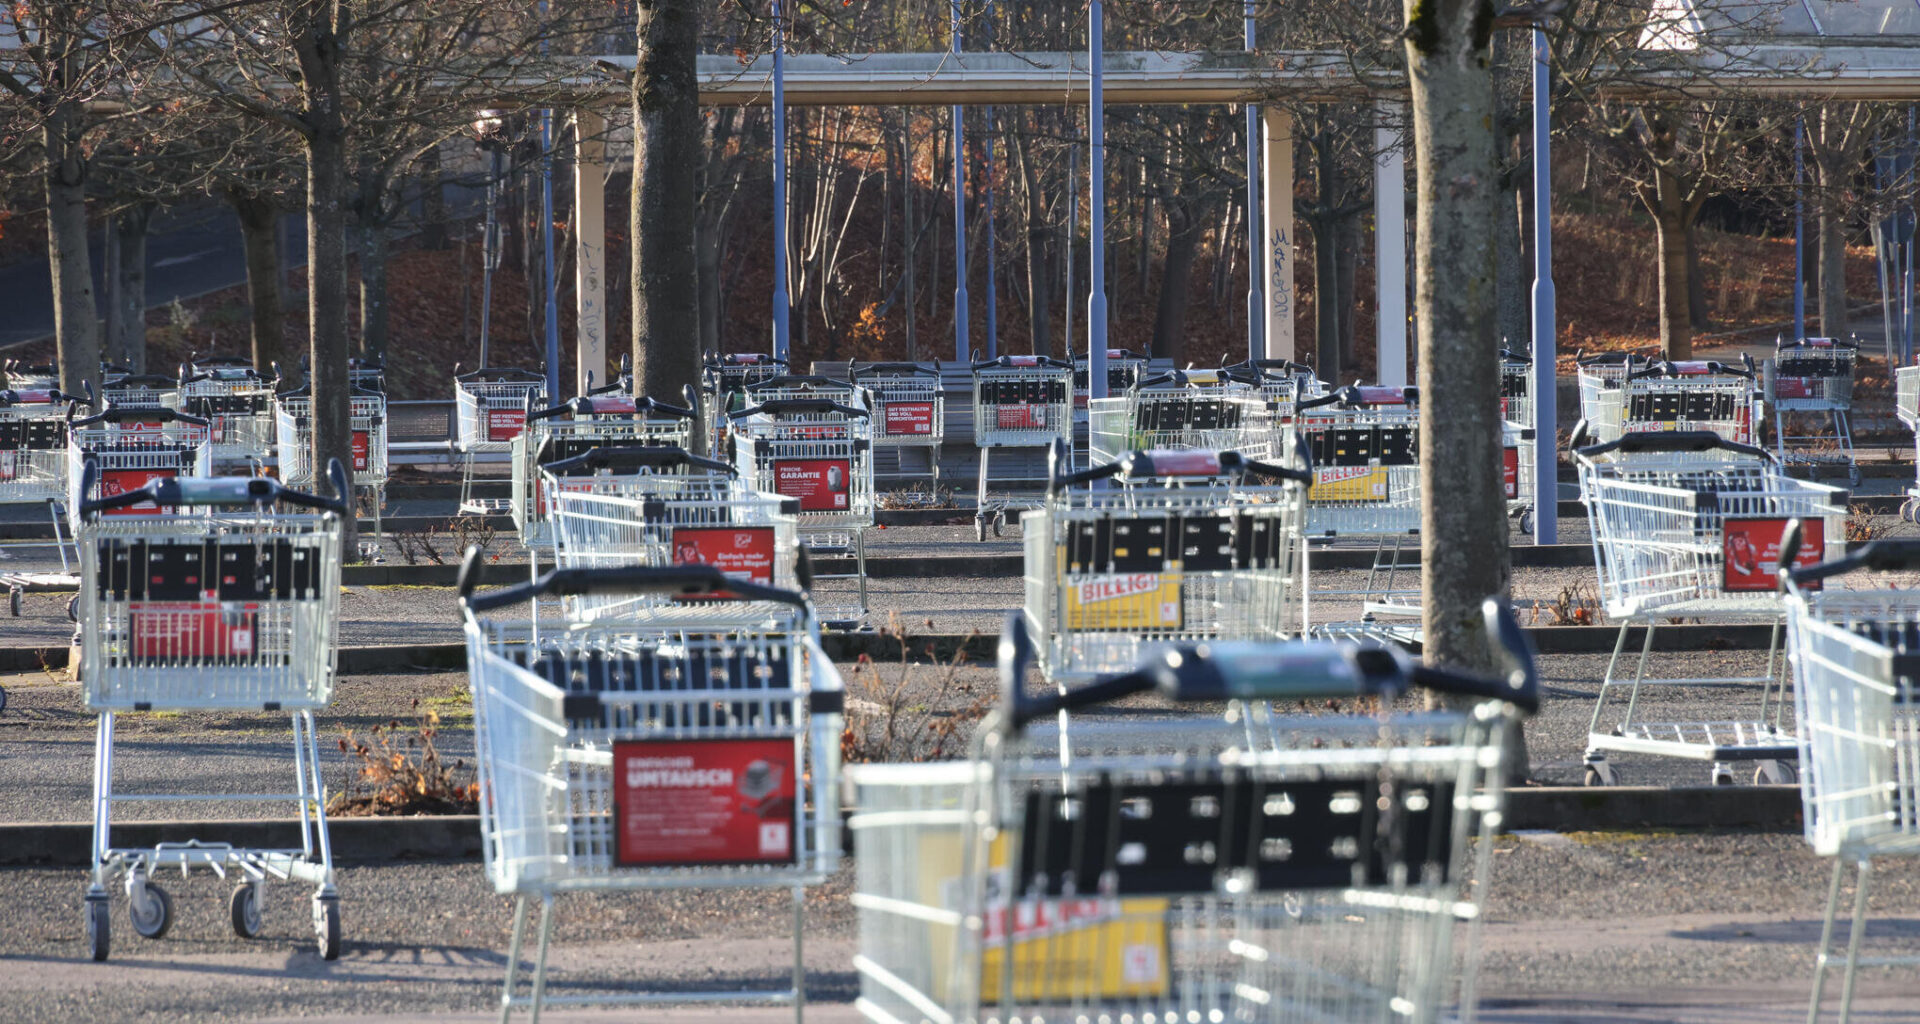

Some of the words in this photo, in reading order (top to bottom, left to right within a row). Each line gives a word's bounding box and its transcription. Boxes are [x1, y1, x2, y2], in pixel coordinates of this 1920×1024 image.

[1082, 573, 1155, 601] BILLIG!
[627, 757, 694, 768] EINFACHER
[627, 768, 733, 788] UMTAUSCH
